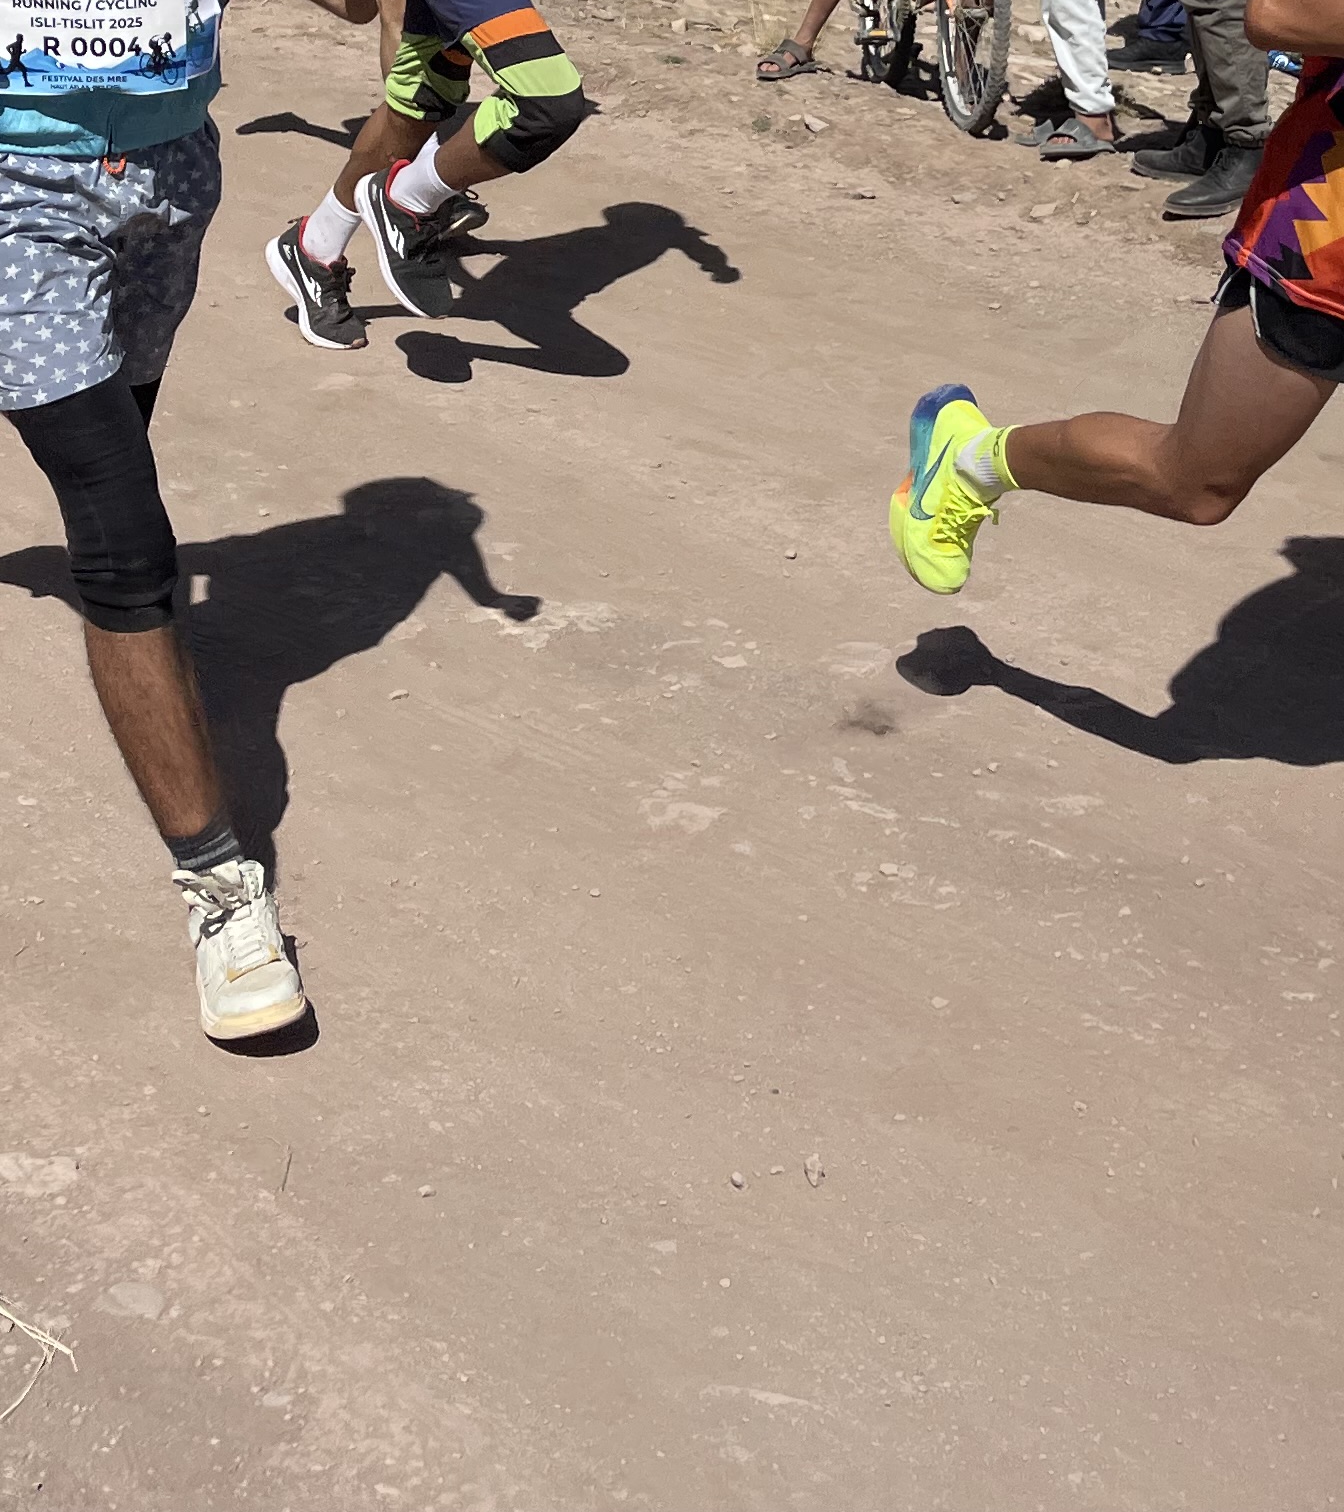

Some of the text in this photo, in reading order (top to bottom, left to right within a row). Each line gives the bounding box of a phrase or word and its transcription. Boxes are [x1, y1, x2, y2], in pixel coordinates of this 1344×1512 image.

[29, 16, 144, 30] ISLI-TISLIT 2025
[43, 35, 142, 58] R 0004
[41, 74, 84, 84] FESTIVAL
[85, 74, 105, 84] DES
